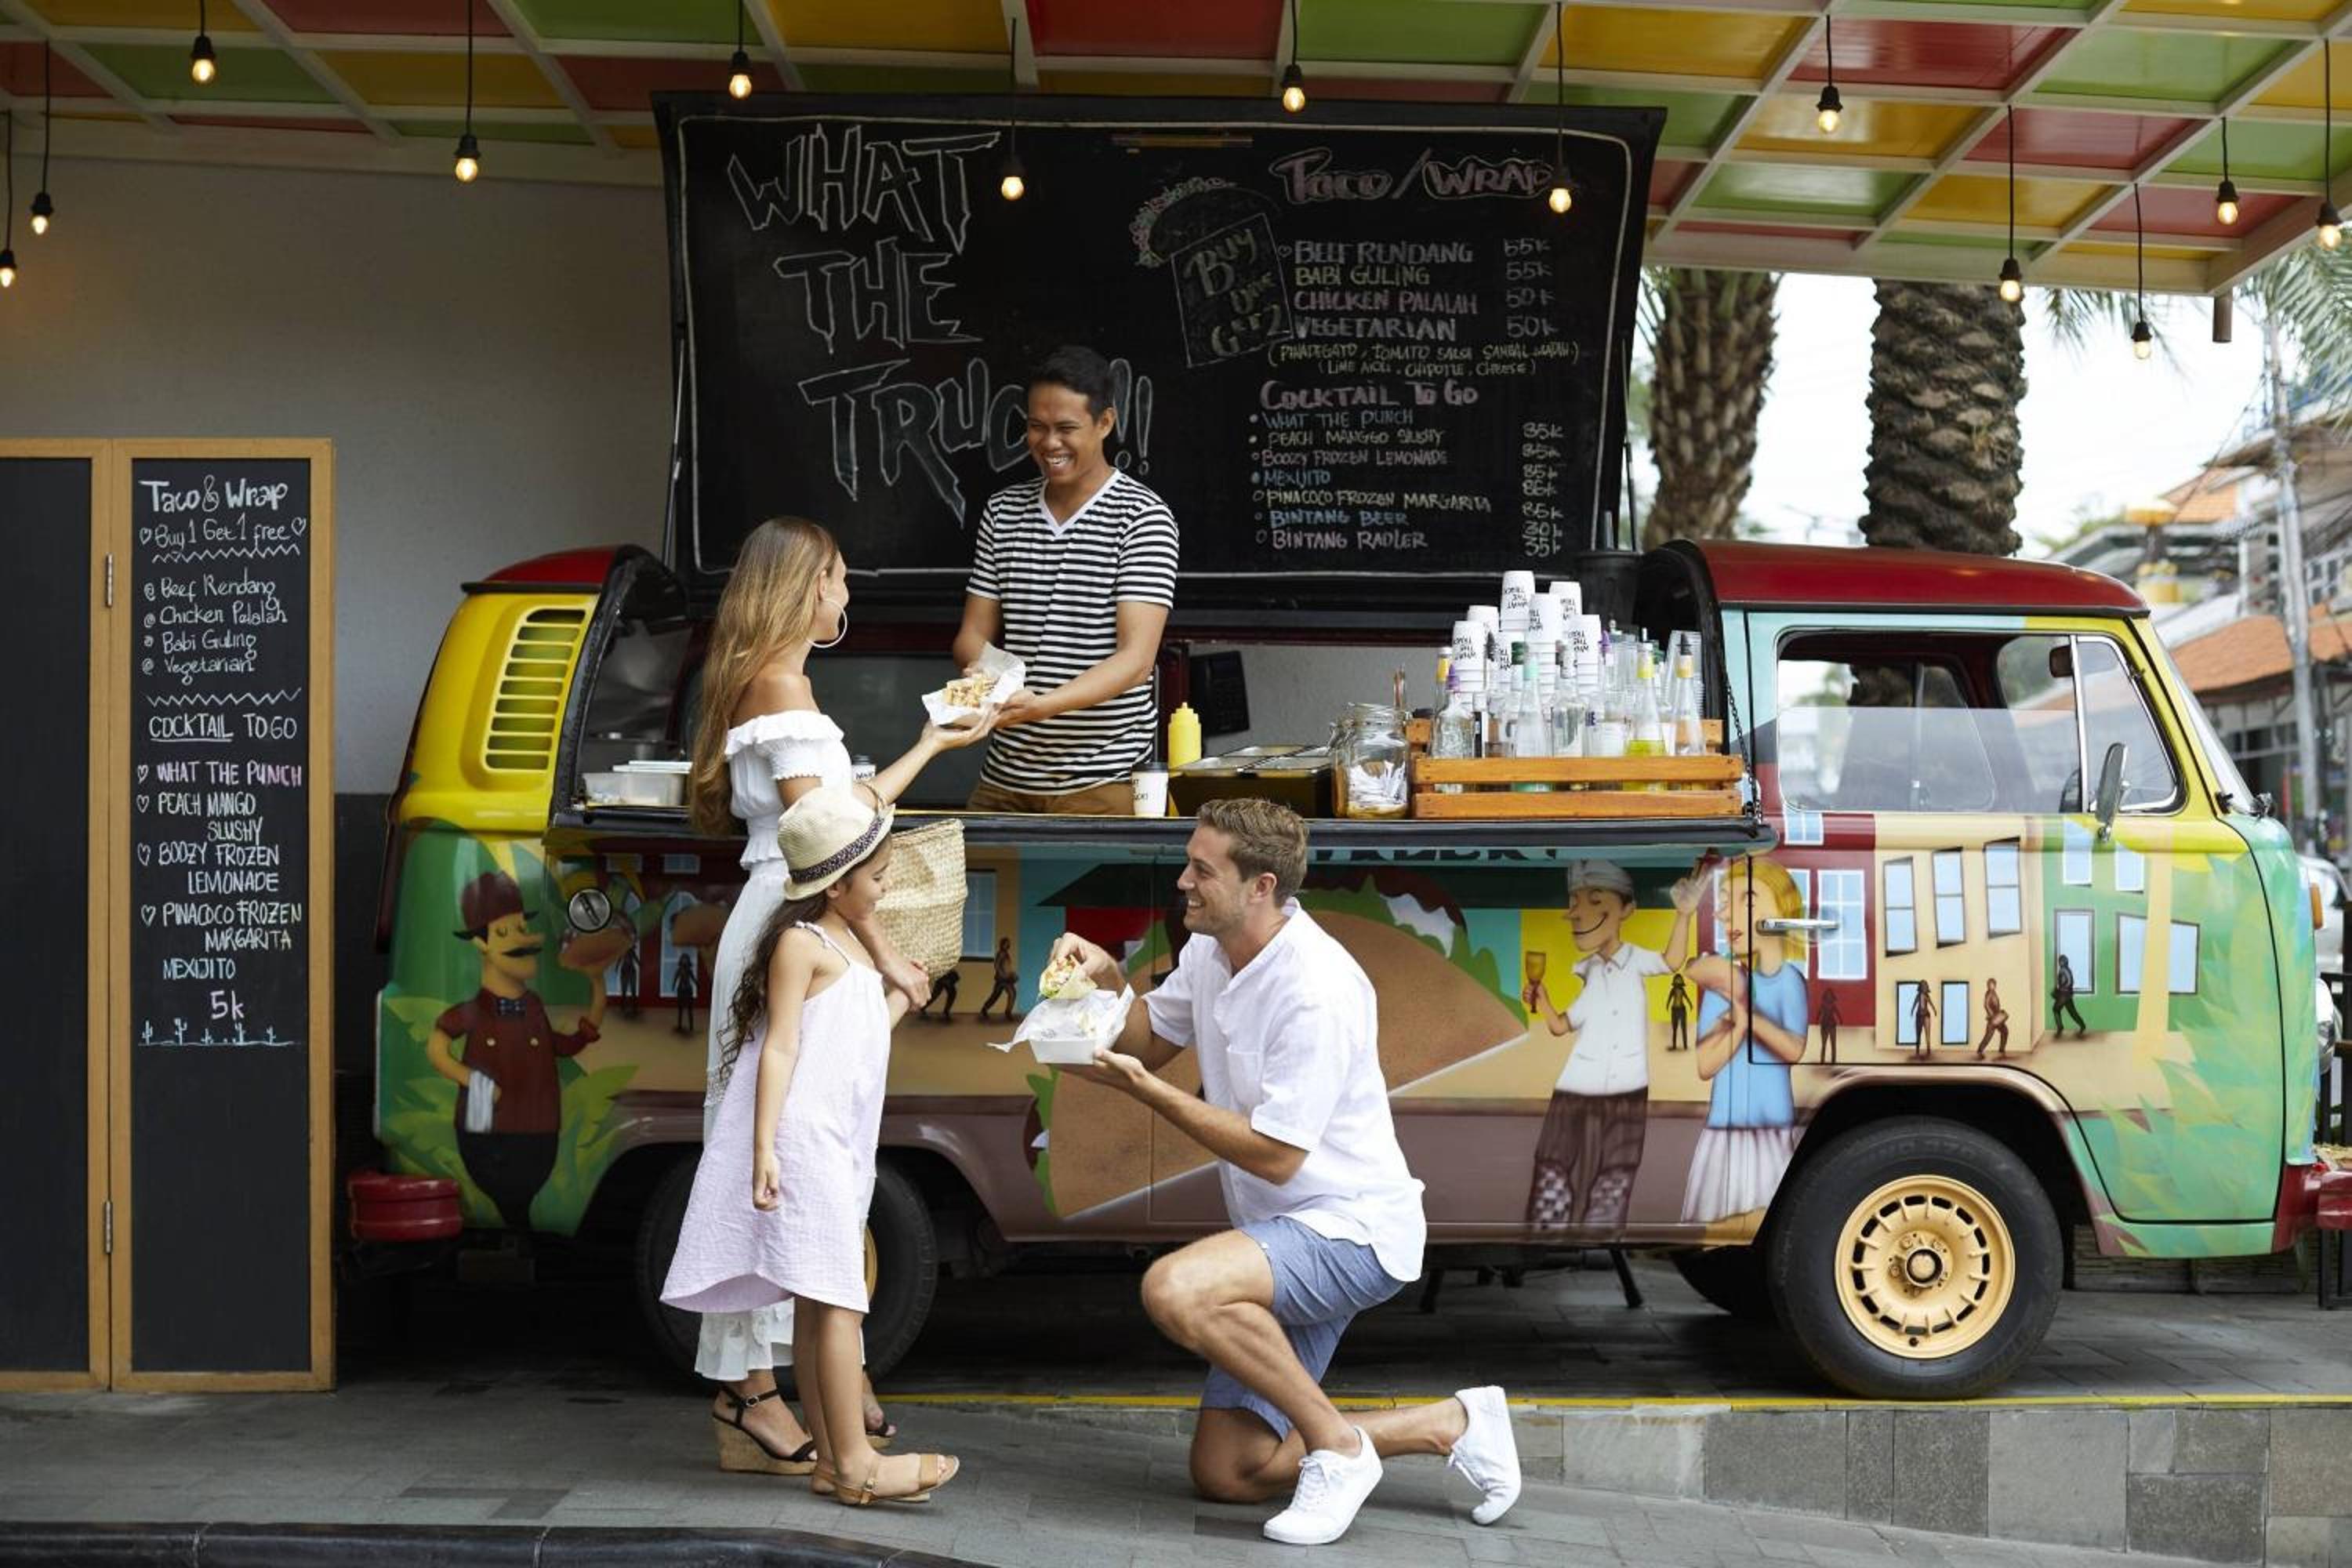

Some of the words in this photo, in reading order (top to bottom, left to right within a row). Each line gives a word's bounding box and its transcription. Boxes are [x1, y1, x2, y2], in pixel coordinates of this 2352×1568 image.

[727, 123, 1001, 255] WHAT
[772, 237, 983, 354] THE
[1294, 315, 1456, 342] VEGETARIAN
[1261, 411, 1308, 430] WHAT
[1315, 411, 1350, 429] THE
[1361, 408, 1414, 429] PUNCH
[1268, 430, 1313, 449] PEACH
[1376, 448, 1448, 467] LEMONADE
[139, 480, 201, 512] Taco
[225, 477, 288, 510] Wrap
[155, 524, 185, 549] Buy
[188, 519, 196, 543] 1
[203, 518, 238, 541] Get
[237, 512, 246, 540] 1
[1359, 510, 1410, 528] BEER
[1356, 529, 1429, 550] RADLER
[161, 576, 196, 602] Beef
[203, 566, 277, 610] Rendang
[159, 603, 225, 625] Chicken
[162, 630, 196, 655] Babi
[201, 629, 257, 660] Guling
[164, 655, 256, 686] Vegetarian
[149, 713, 234, 739] COCKTAIL
[157, 760, 200, 784] WHAT
[206, 761, 239, 786] THE
[247, 760, 302, 786] PUNCH
[158, 792, 201, 817] PEACH
[207, 791, 256, 817] MANGO
[207, 816, 263, 846] SLUSHY
[158, 841, 208, 866] BOOZY
[215, 844, 279, 866] FROZEN
[187, 870, 280, 895] LEMONADE
[235, 899, 302, 927] FROZEN
[204, 927, 292, 953] MARGARITA
